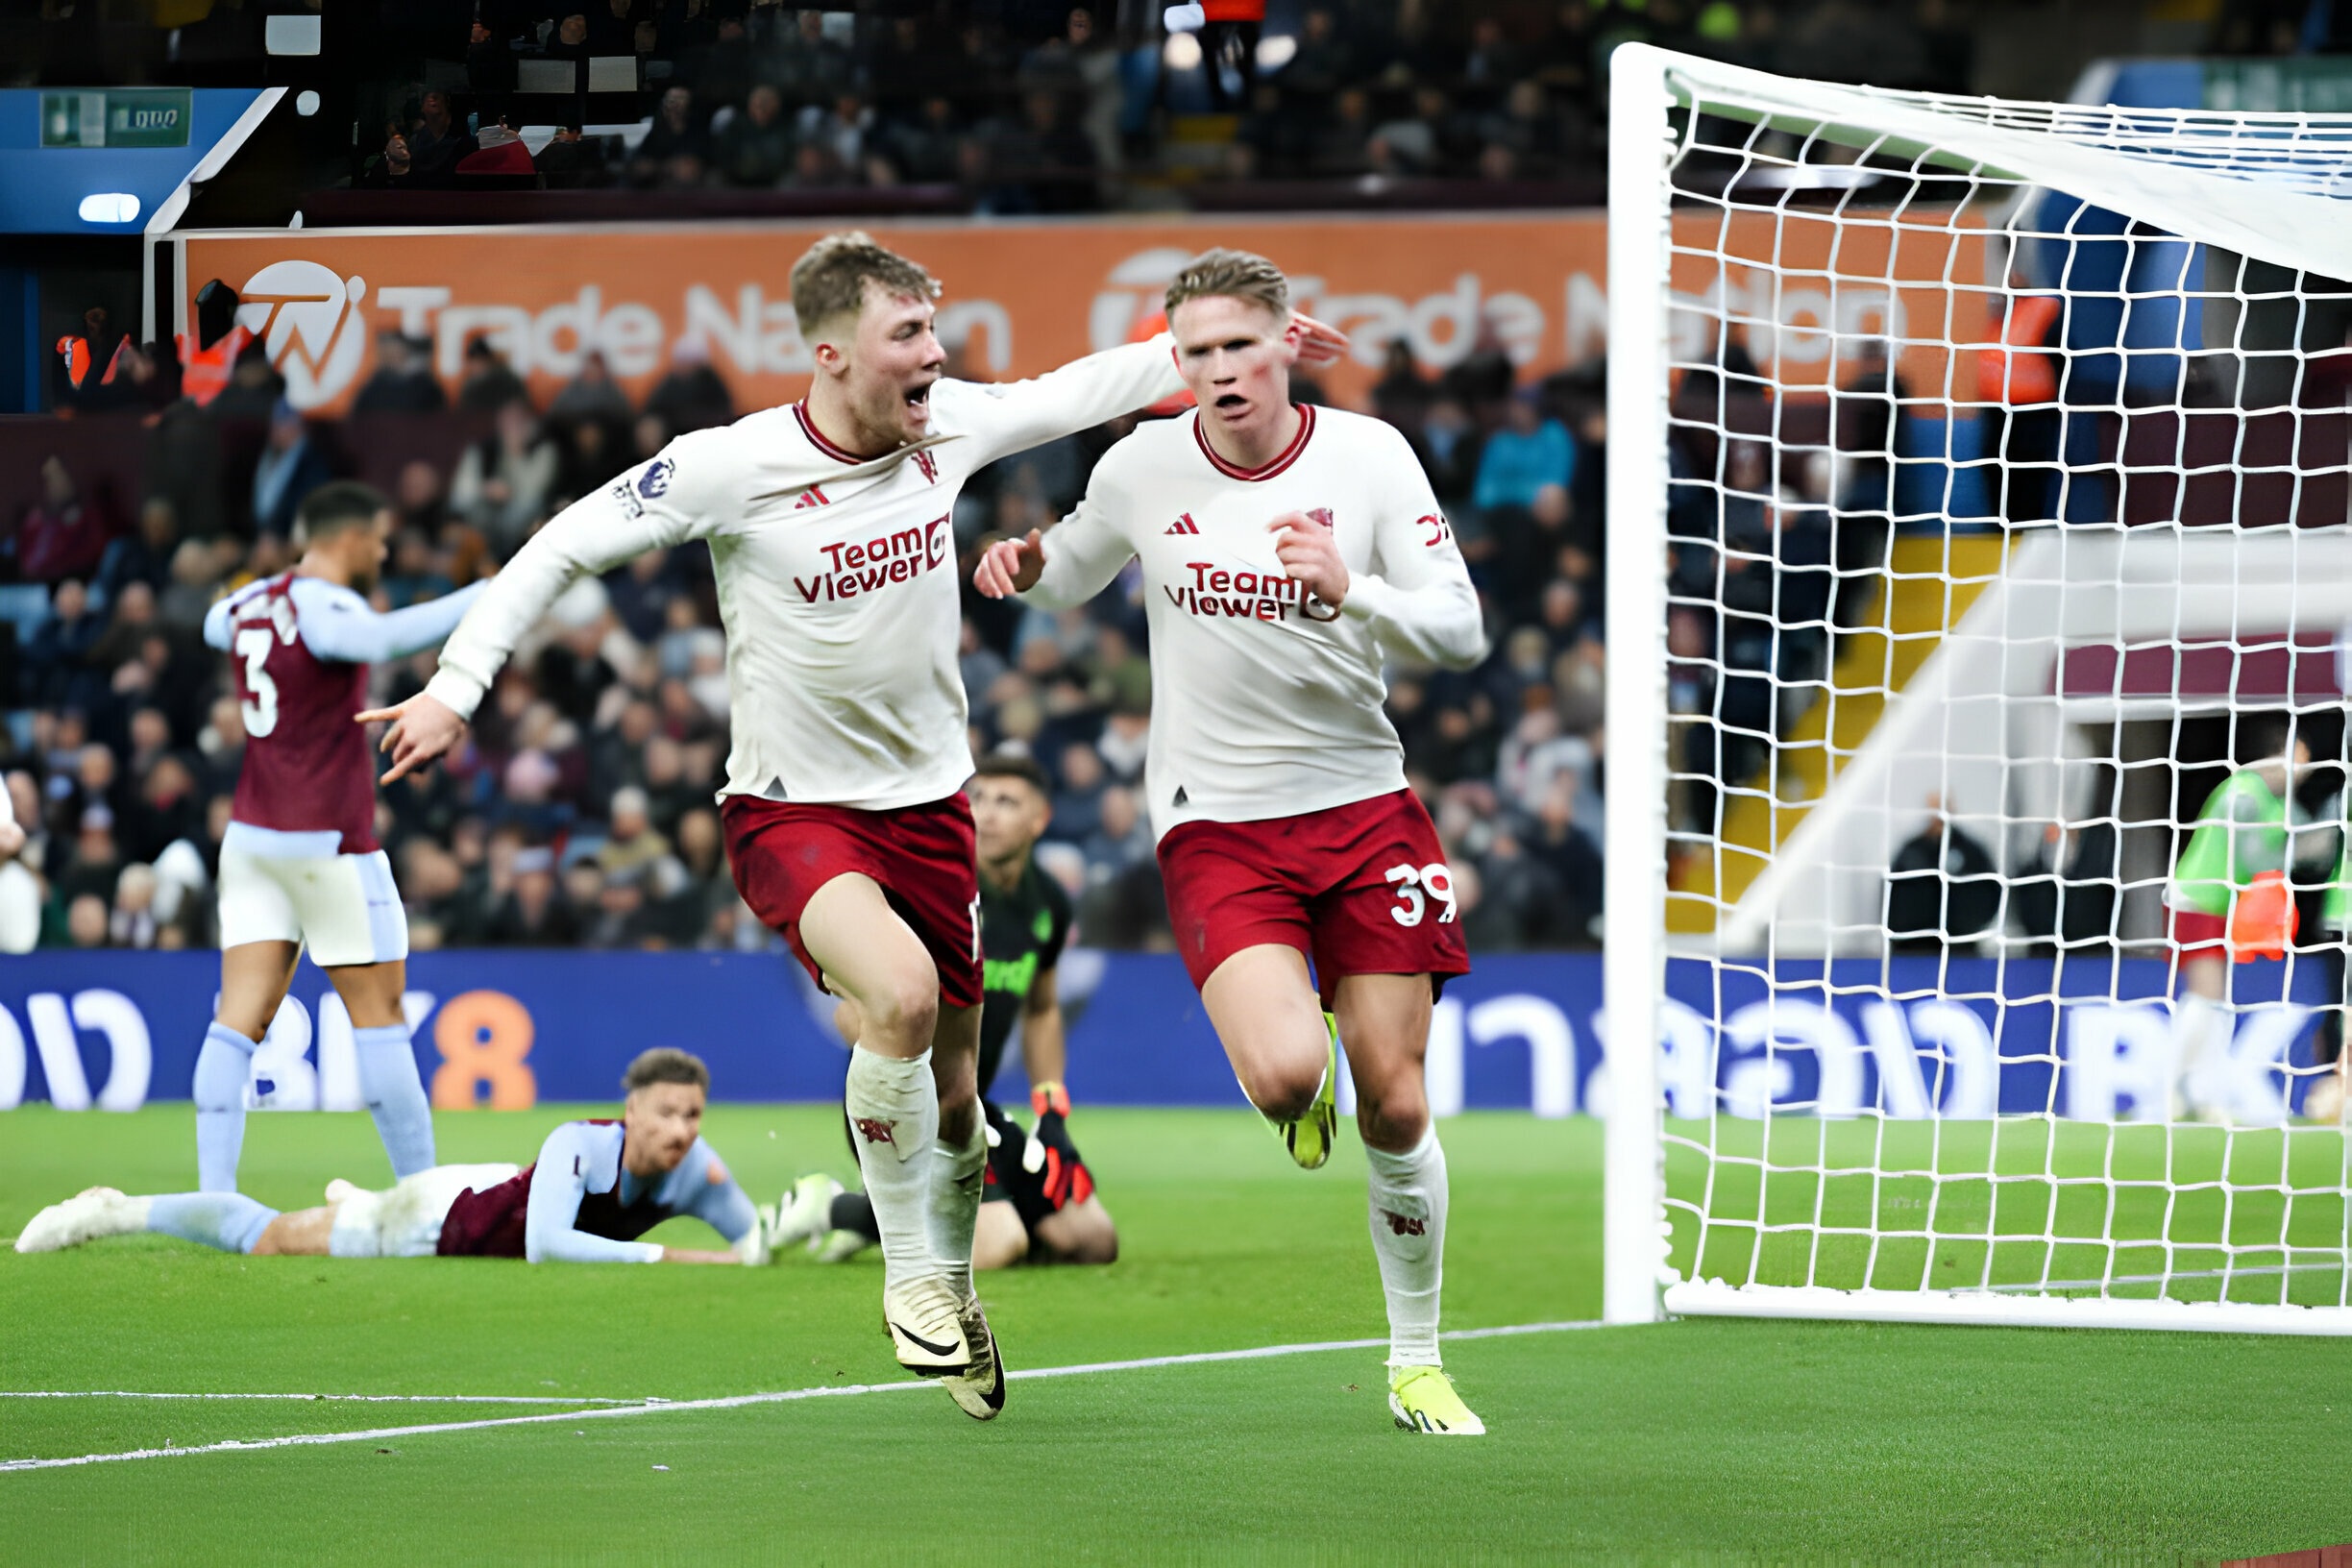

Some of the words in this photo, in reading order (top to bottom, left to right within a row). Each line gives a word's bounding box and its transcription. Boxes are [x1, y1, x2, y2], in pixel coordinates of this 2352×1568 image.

[377, 284, 663, 379] Trade
[820, 527, 922, 575] Team
[1186, 561, 1296, 600] Team
[235, 627, 279, 739] 3
[1384, 863, 1457, 926] 39
